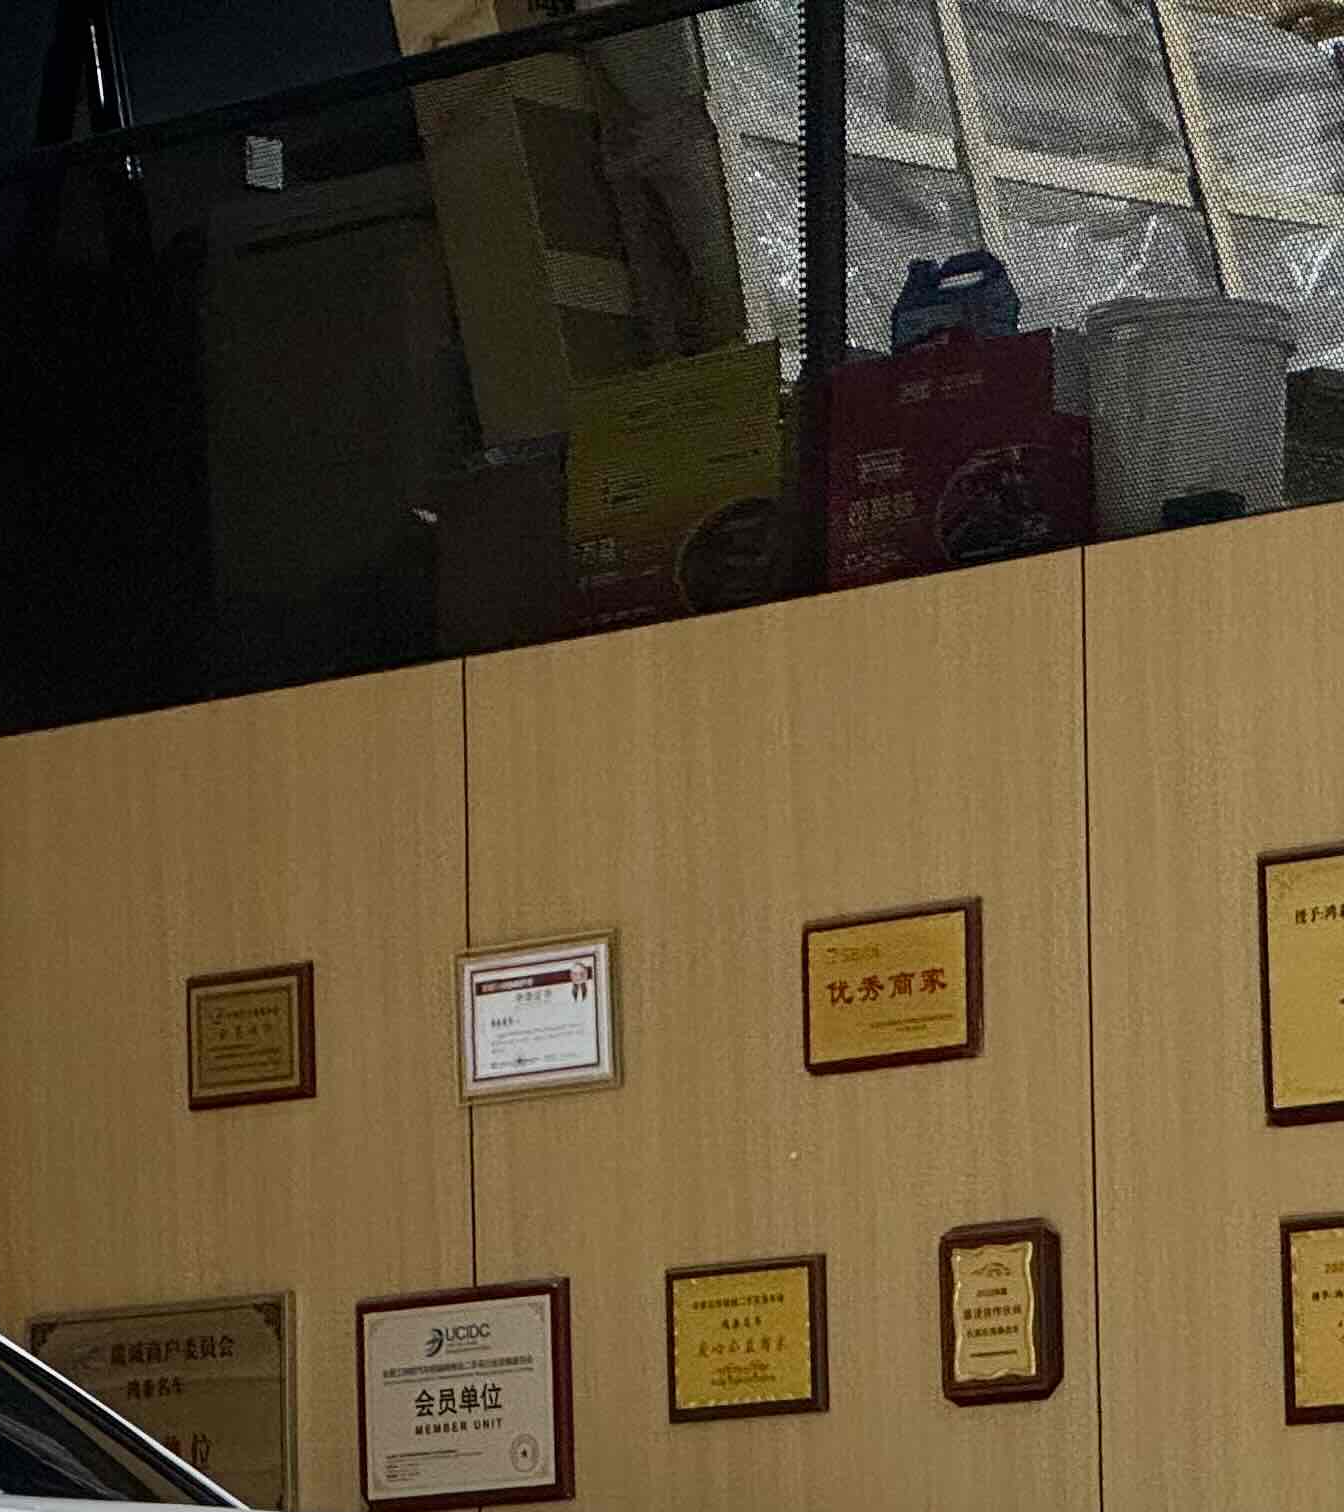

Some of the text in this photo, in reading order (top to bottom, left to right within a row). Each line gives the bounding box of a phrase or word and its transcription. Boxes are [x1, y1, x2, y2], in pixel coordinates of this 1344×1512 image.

[826, 967, 948, 1006] 优秀商家
[445, 1322, 491, 1342] UCIDC
[415, 1382, 503, 1418] 会员单位
[415, 1417, 503, 1435] MEMBER UNIT
